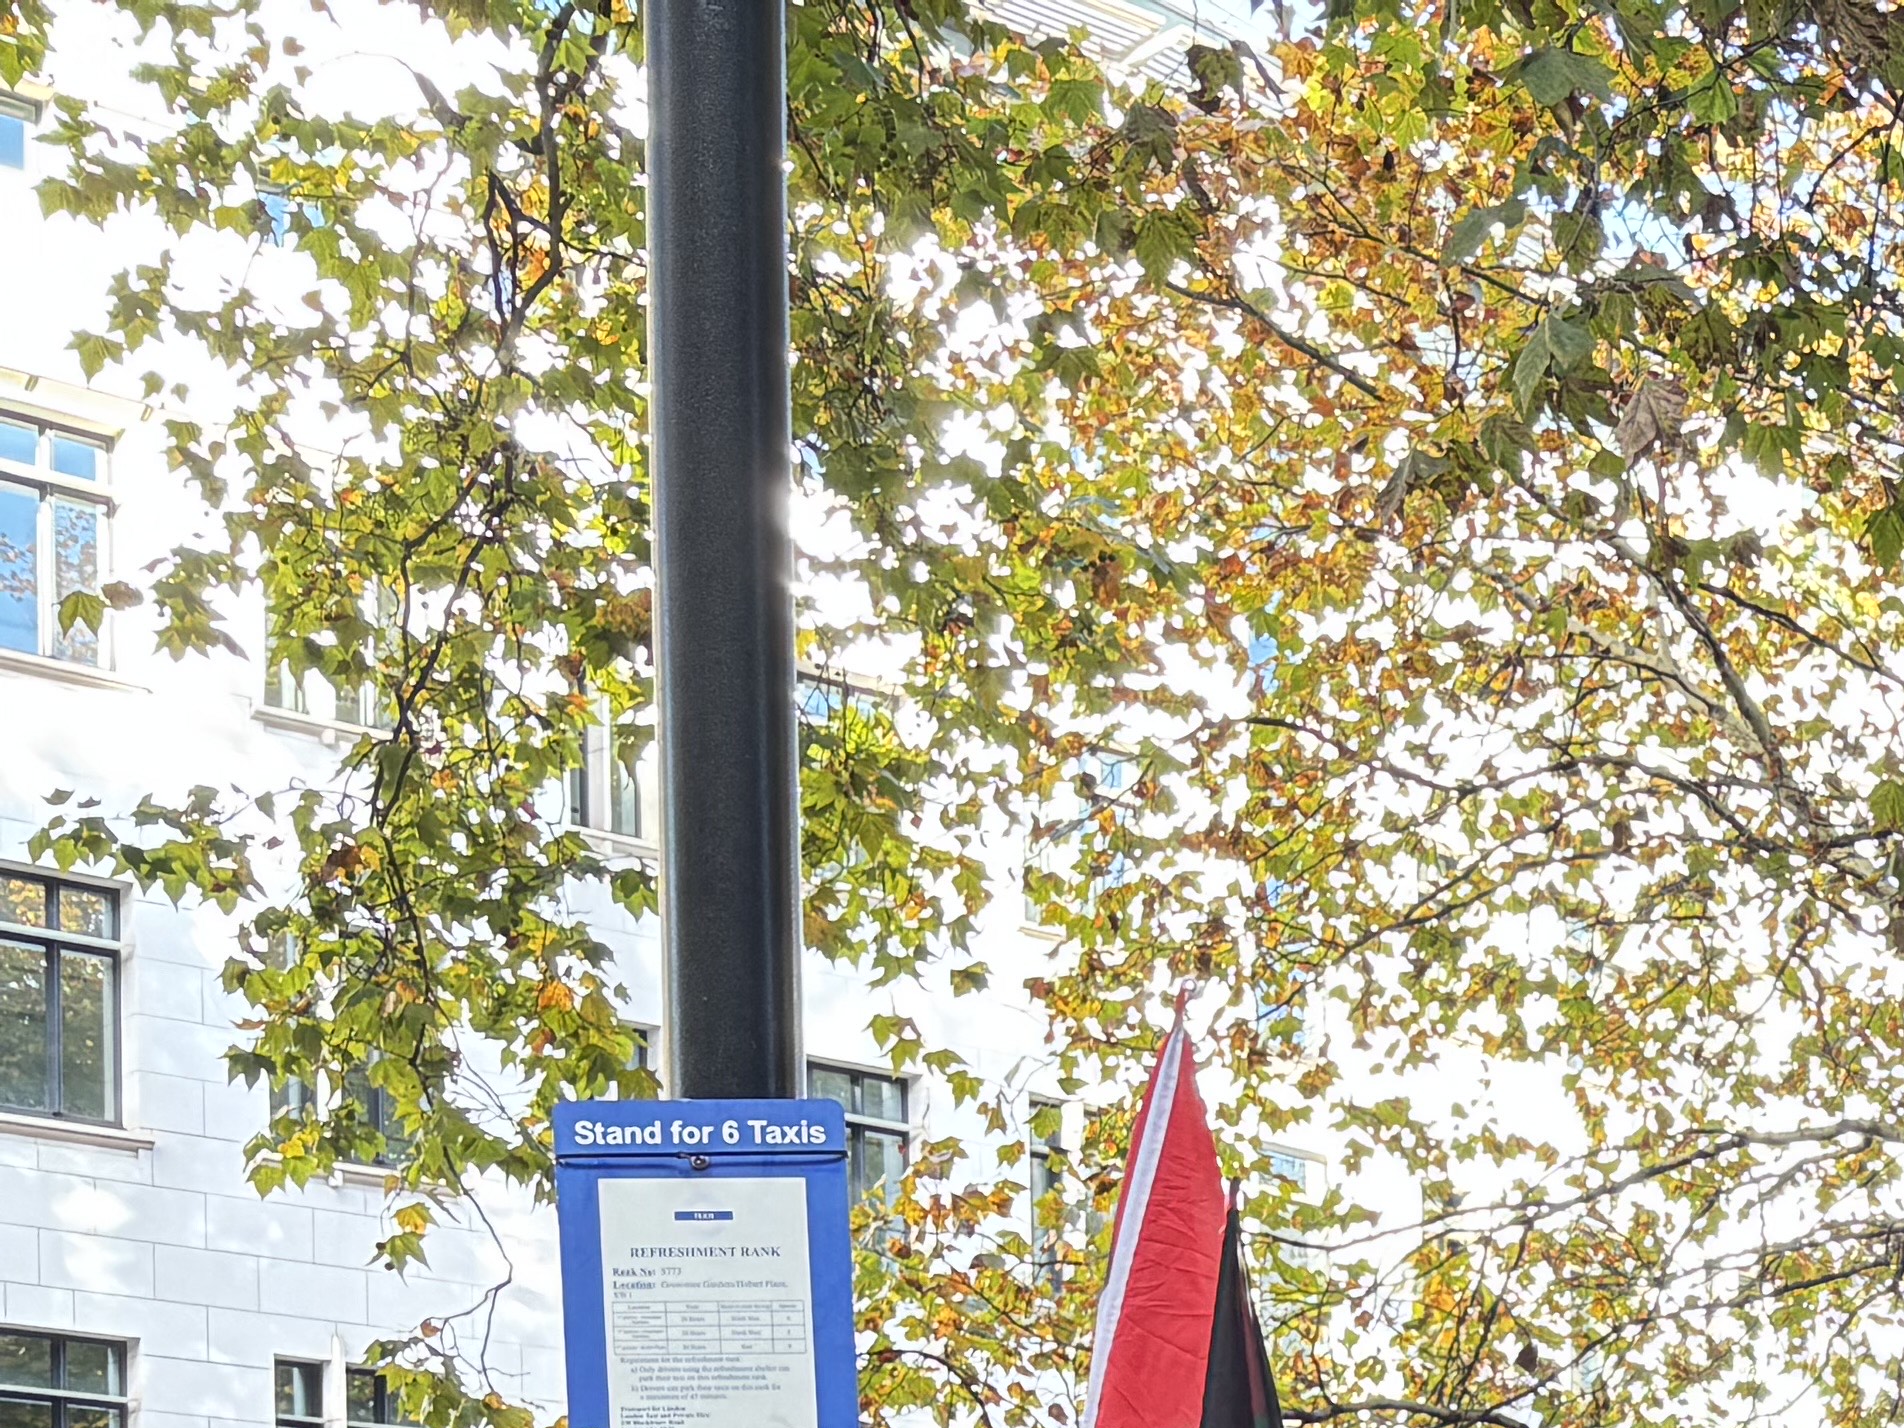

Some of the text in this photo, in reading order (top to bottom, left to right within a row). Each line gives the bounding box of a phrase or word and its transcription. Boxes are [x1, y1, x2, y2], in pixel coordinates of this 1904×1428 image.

[574, 1119, 827, 1146] Stand for 6 Taxis
[630, 1246, 781, 1259] REFRESHMENT RANK
